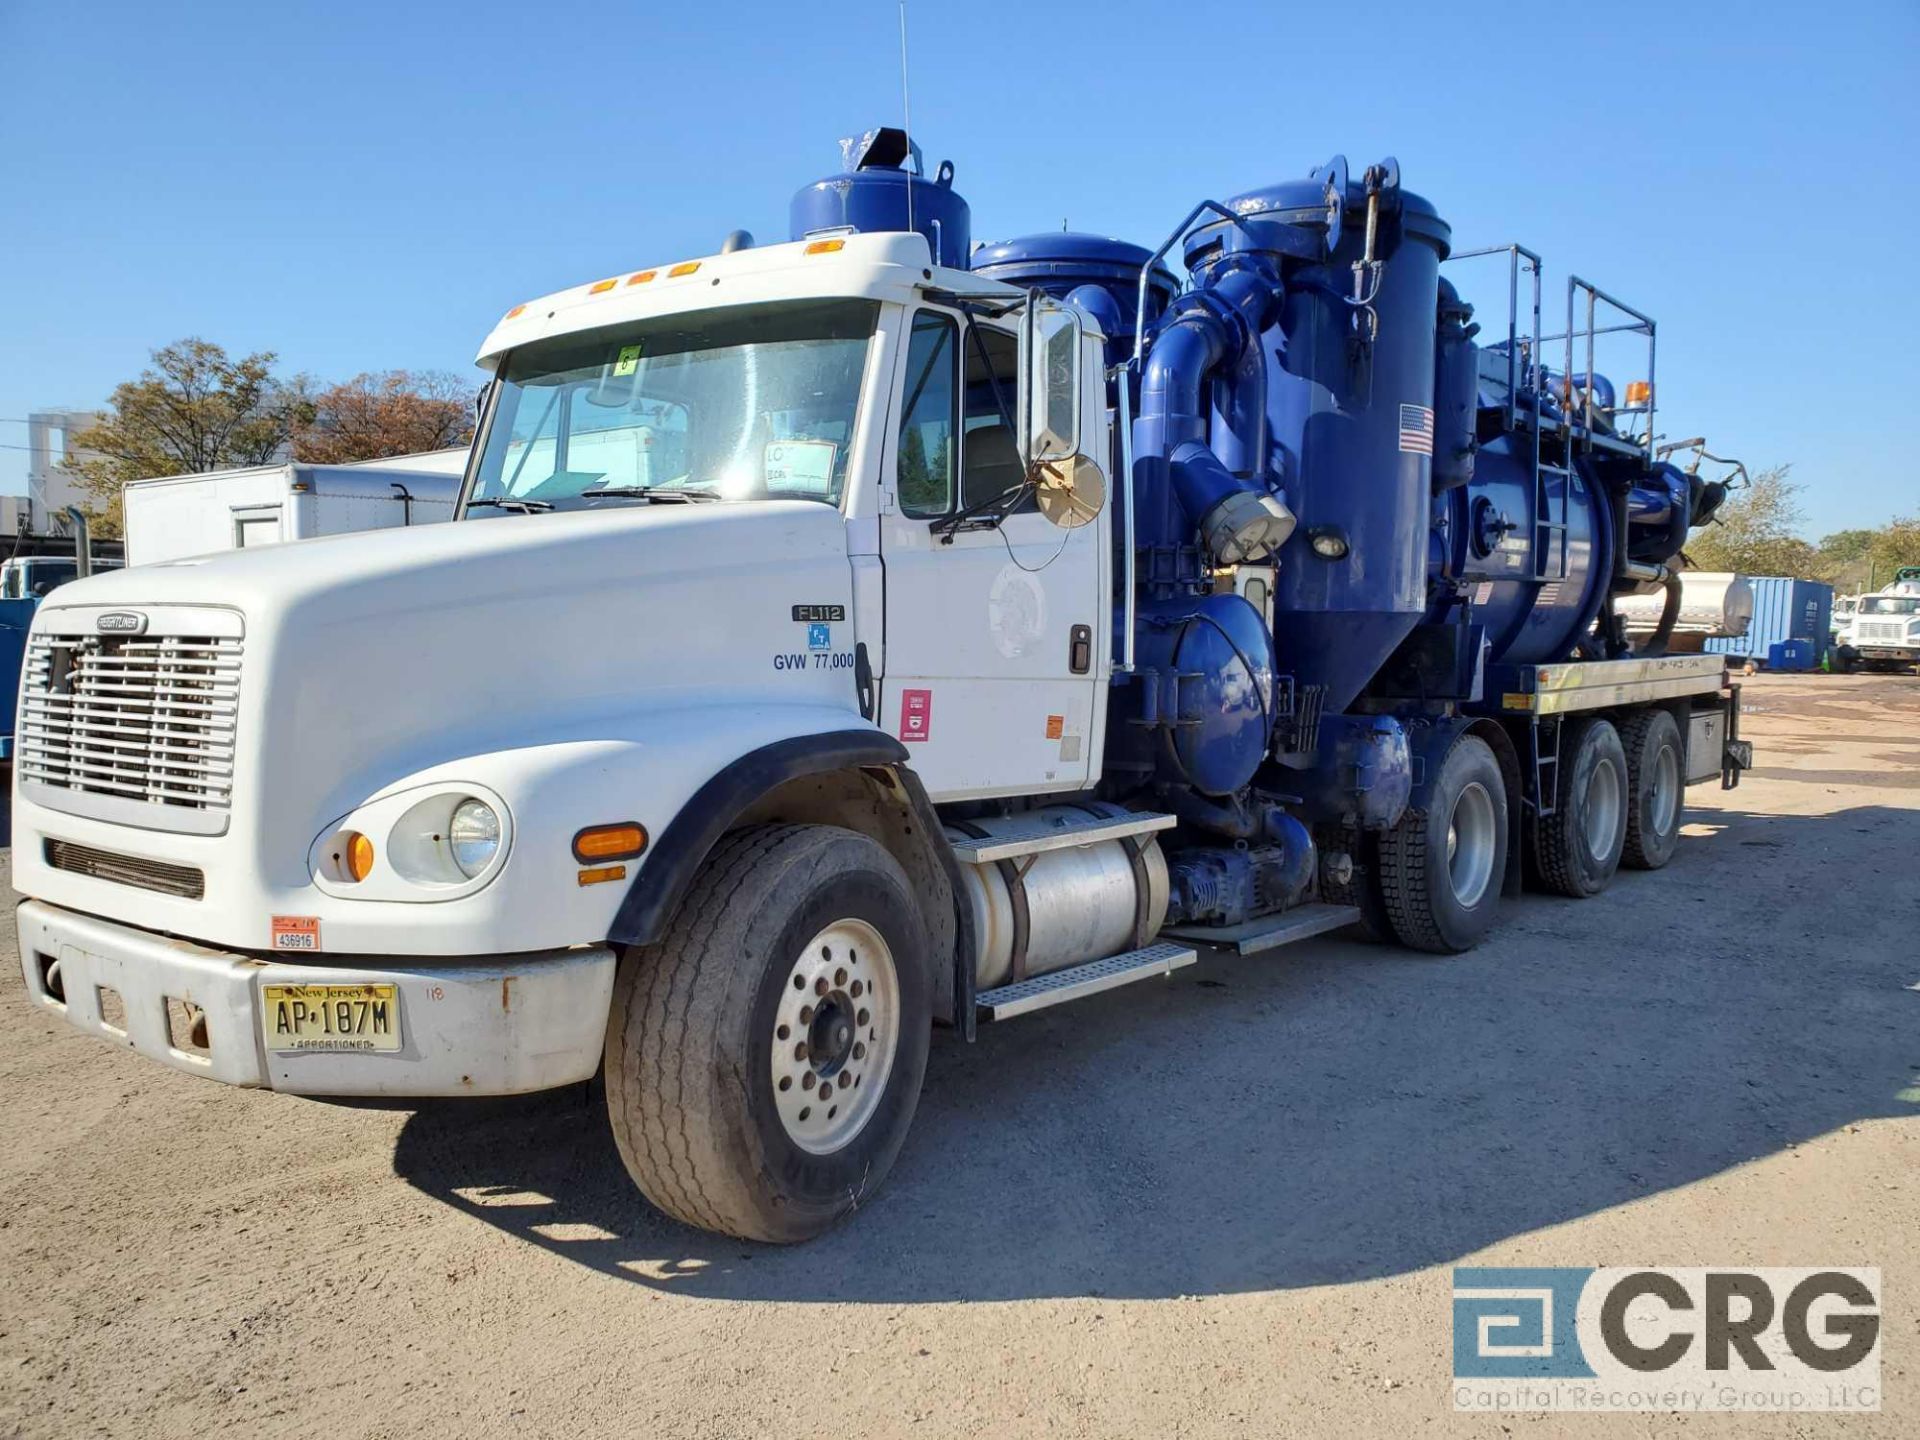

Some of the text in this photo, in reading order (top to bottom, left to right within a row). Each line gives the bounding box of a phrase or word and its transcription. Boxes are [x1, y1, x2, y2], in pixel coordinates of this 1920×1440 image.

[799, 606, 841, 620] FL112
[774, 653, 854, 671] GVW 77,000
[280, 934, 312, 947] 436916
[294, 987, 363, 999] New Jersey
[297, 1040, 370, 1050] APPORTIONED
